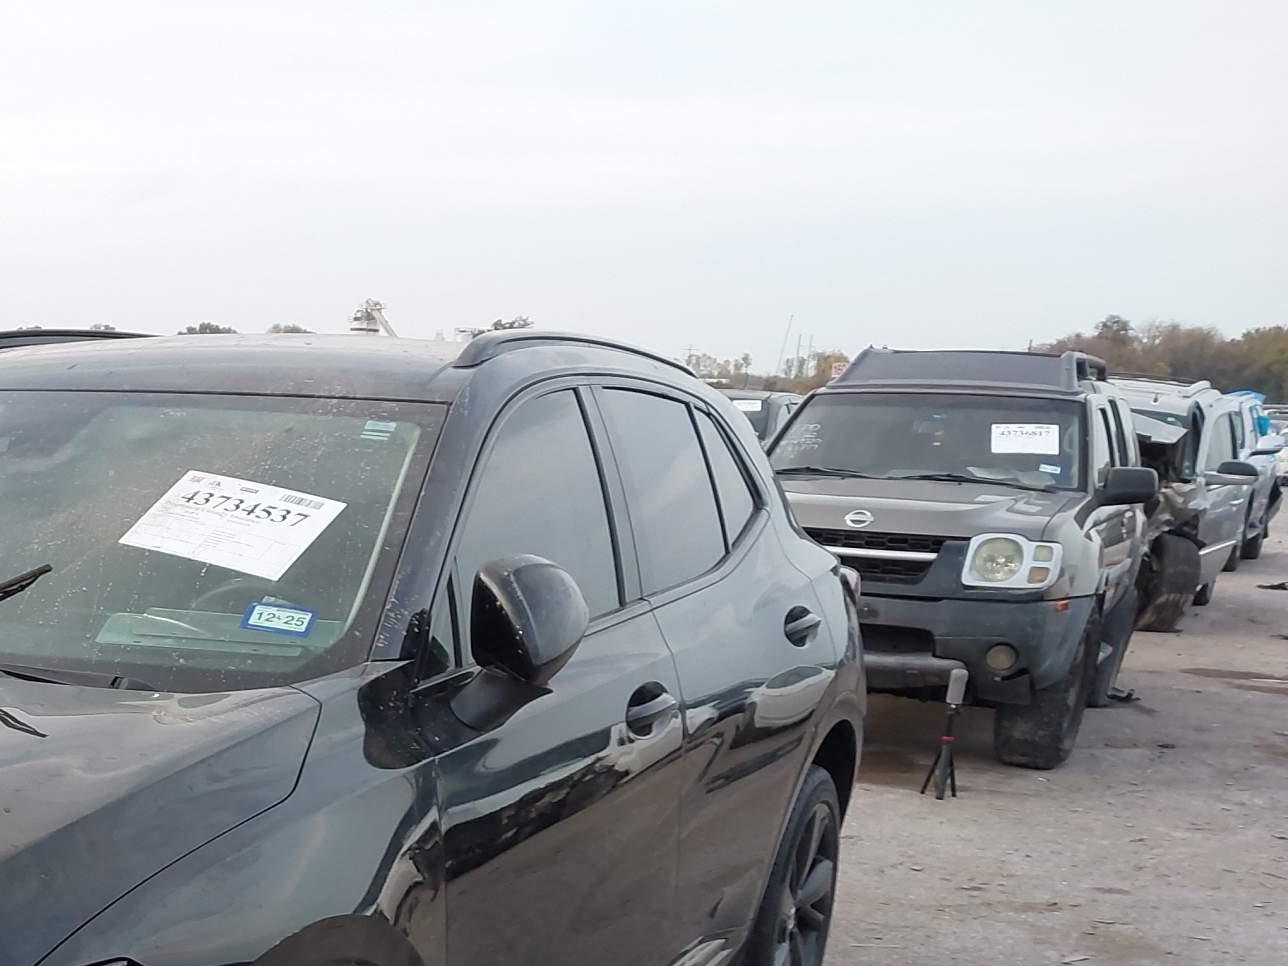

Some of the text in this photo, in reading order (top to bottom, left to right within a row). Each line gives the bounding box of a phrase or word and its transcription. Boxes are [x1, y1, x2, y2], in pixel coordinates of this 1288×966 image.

[181, 490, 311, 527] 43734537
[256, 611, 307, 627] 12 25
